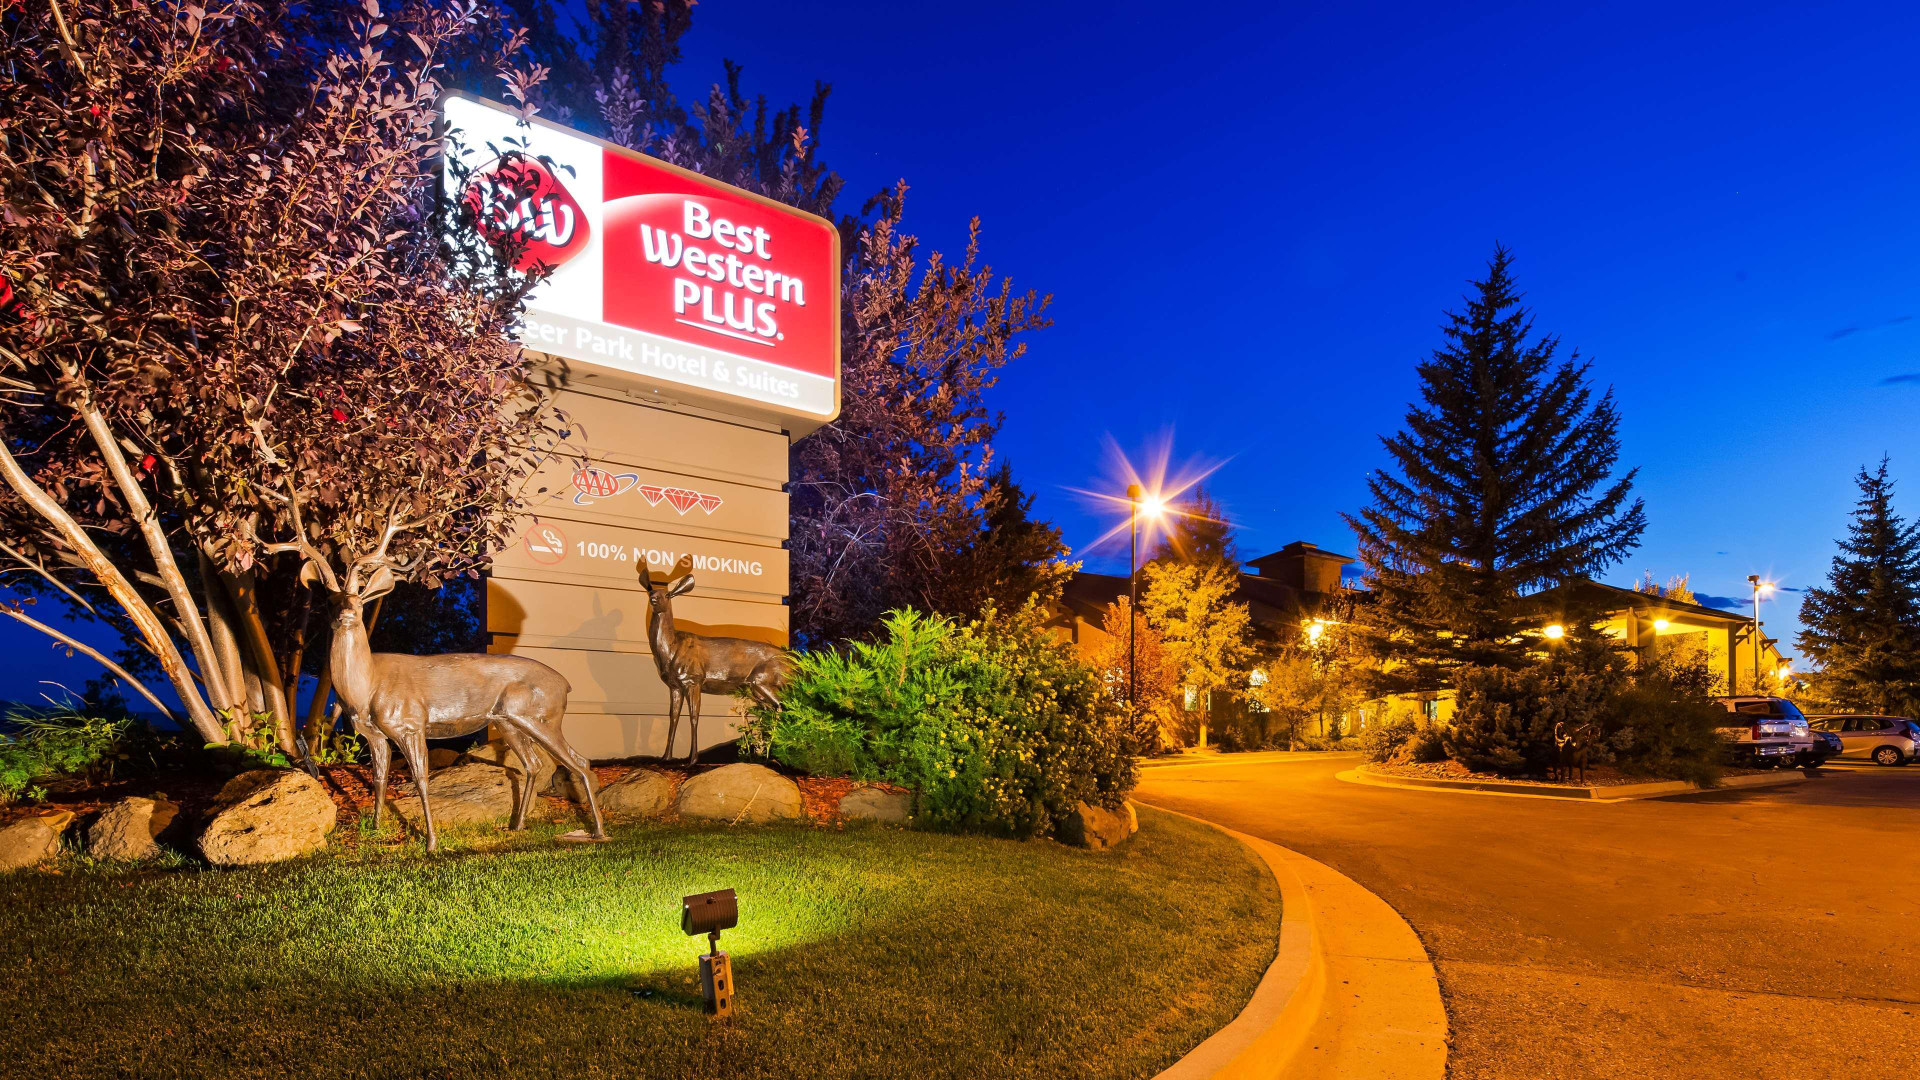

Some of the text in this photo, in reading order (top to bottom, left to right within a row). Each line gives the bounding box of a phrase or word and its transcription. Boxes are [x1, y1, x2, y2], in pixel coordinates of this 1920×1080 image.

[684, 200, 772, 260] Best
[640, 223, 806, 306] Western
[523, 317, 799, 399] eer Park Hotel & Suites
[573, 469, 618, 496] AAA
[576, 541, 763, 576] 100% NON SMOKING
